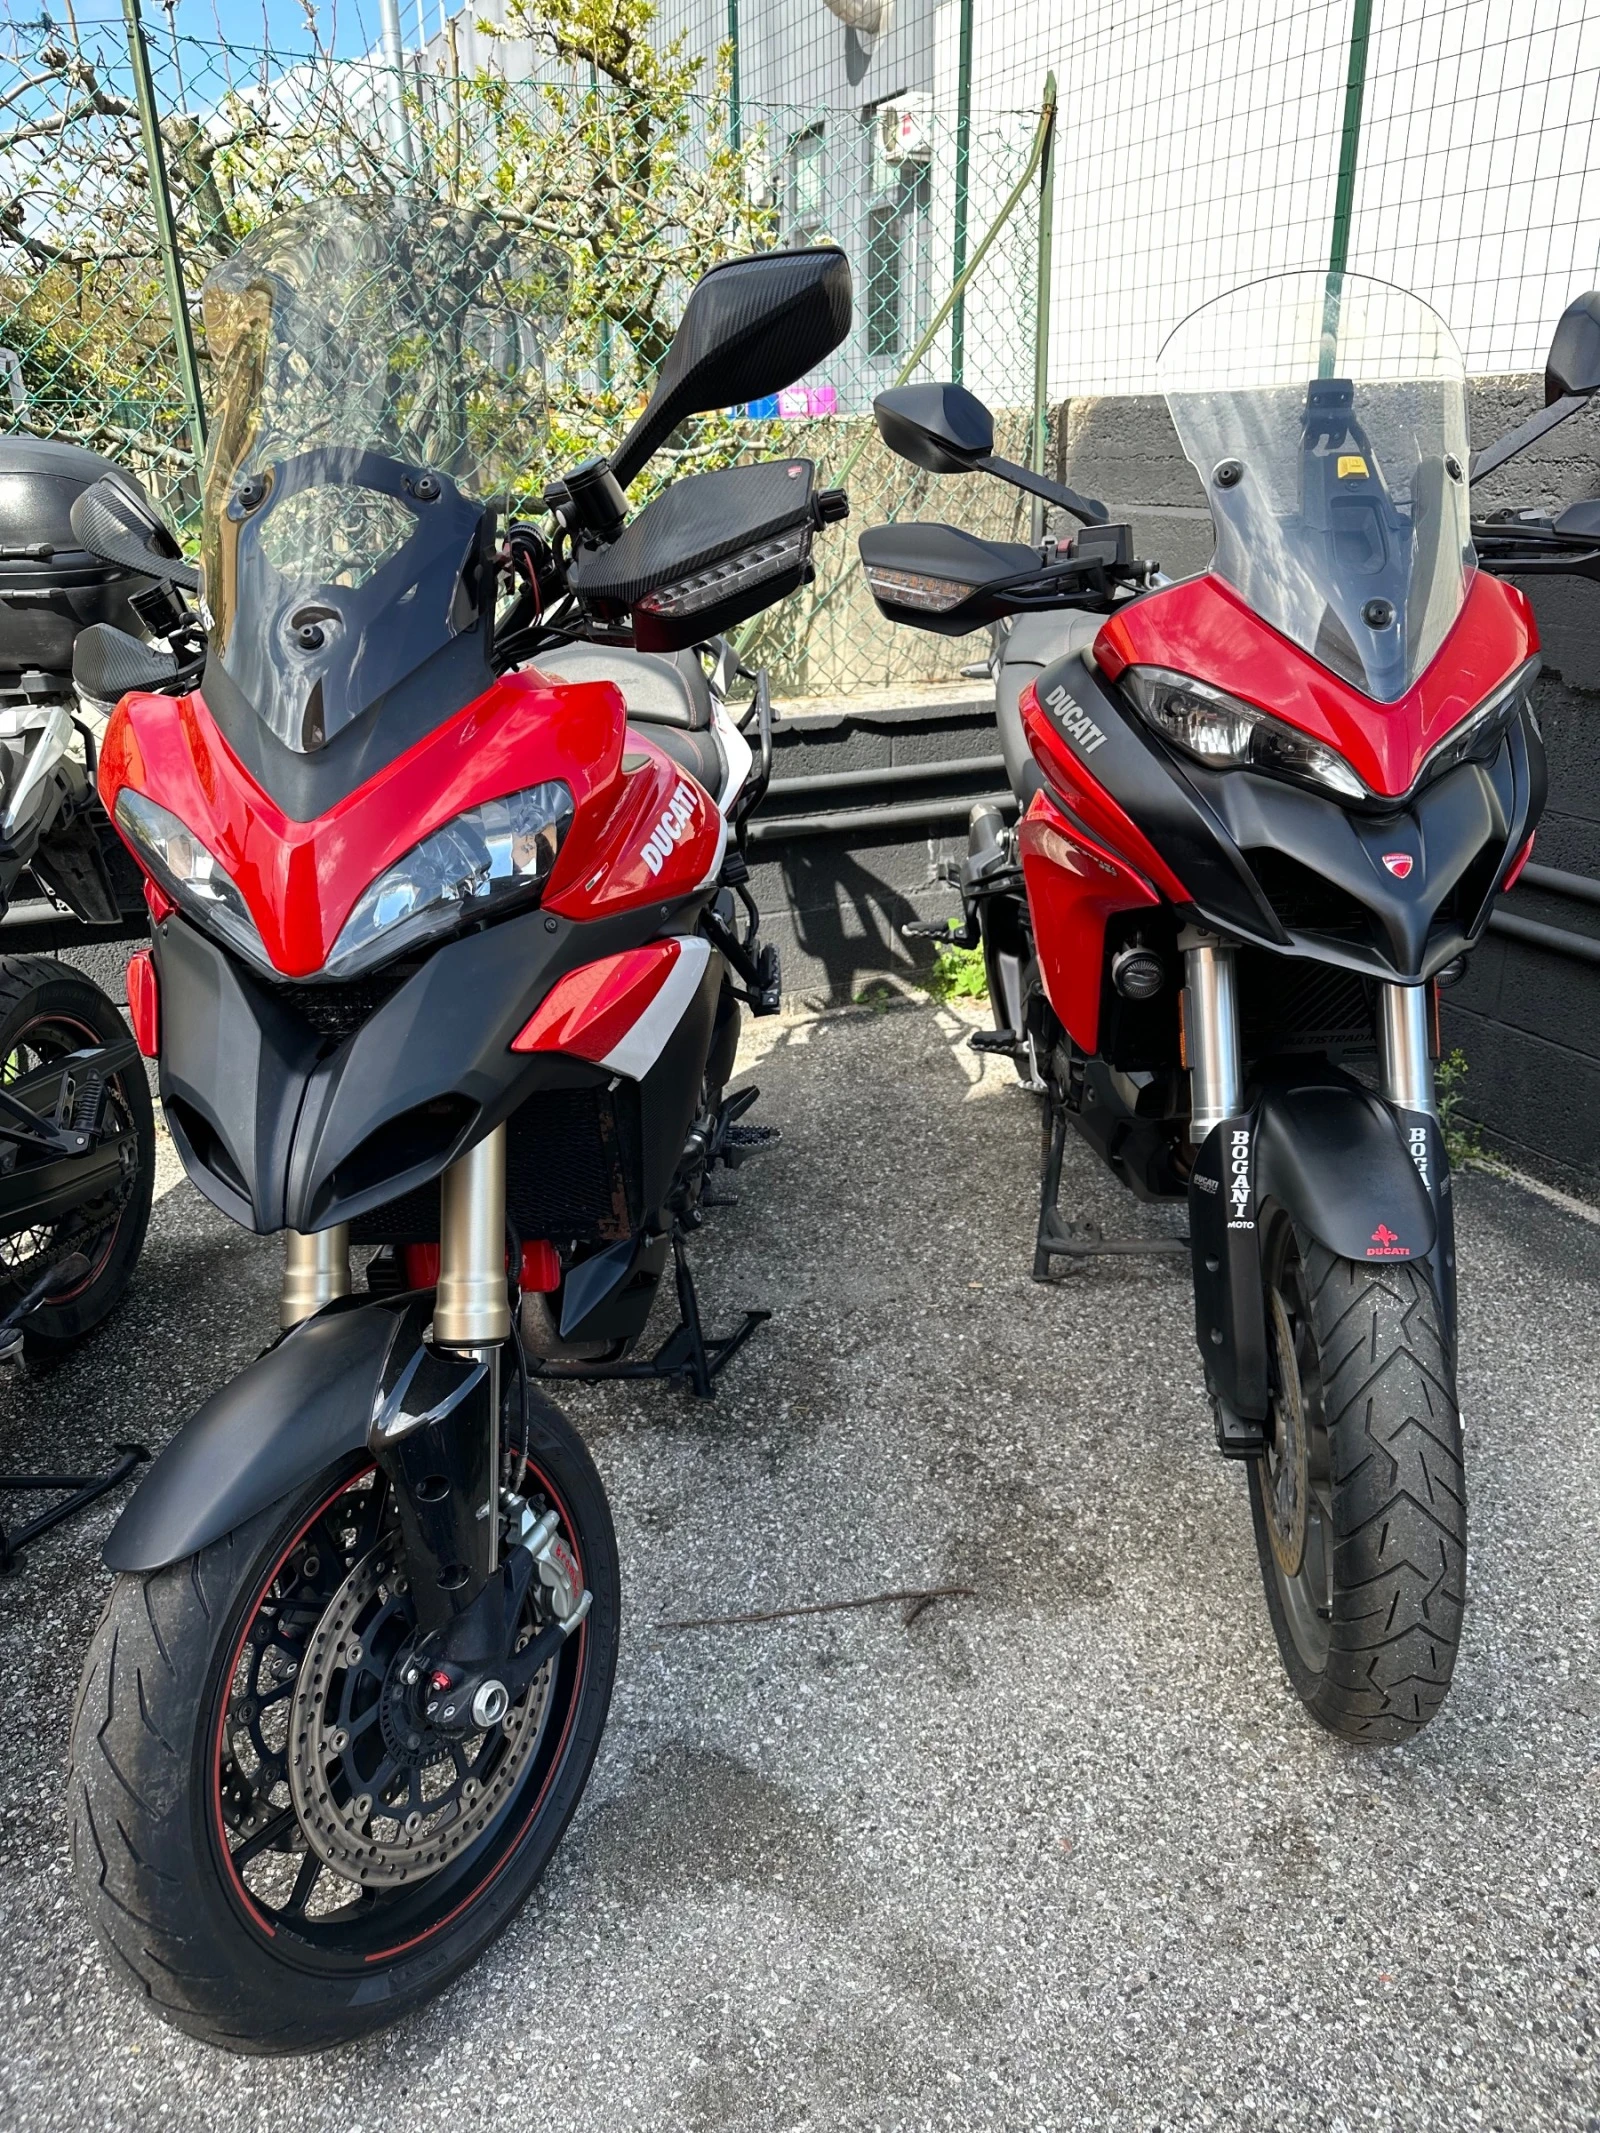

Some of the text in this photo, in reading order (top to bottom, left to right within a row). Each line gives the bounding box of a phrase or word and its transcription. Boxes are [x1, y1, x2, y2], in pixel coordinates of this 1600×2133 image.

[1045, 684, 1108, 754] DUCATI
[640, 780, 698, 877] DUCATI
[1229, 1130, 1251, 1218] BOGANI
[1227, 1220, 1255, 1229] MOTO
[1366, 1247, 1410, 1256] DUCATI
